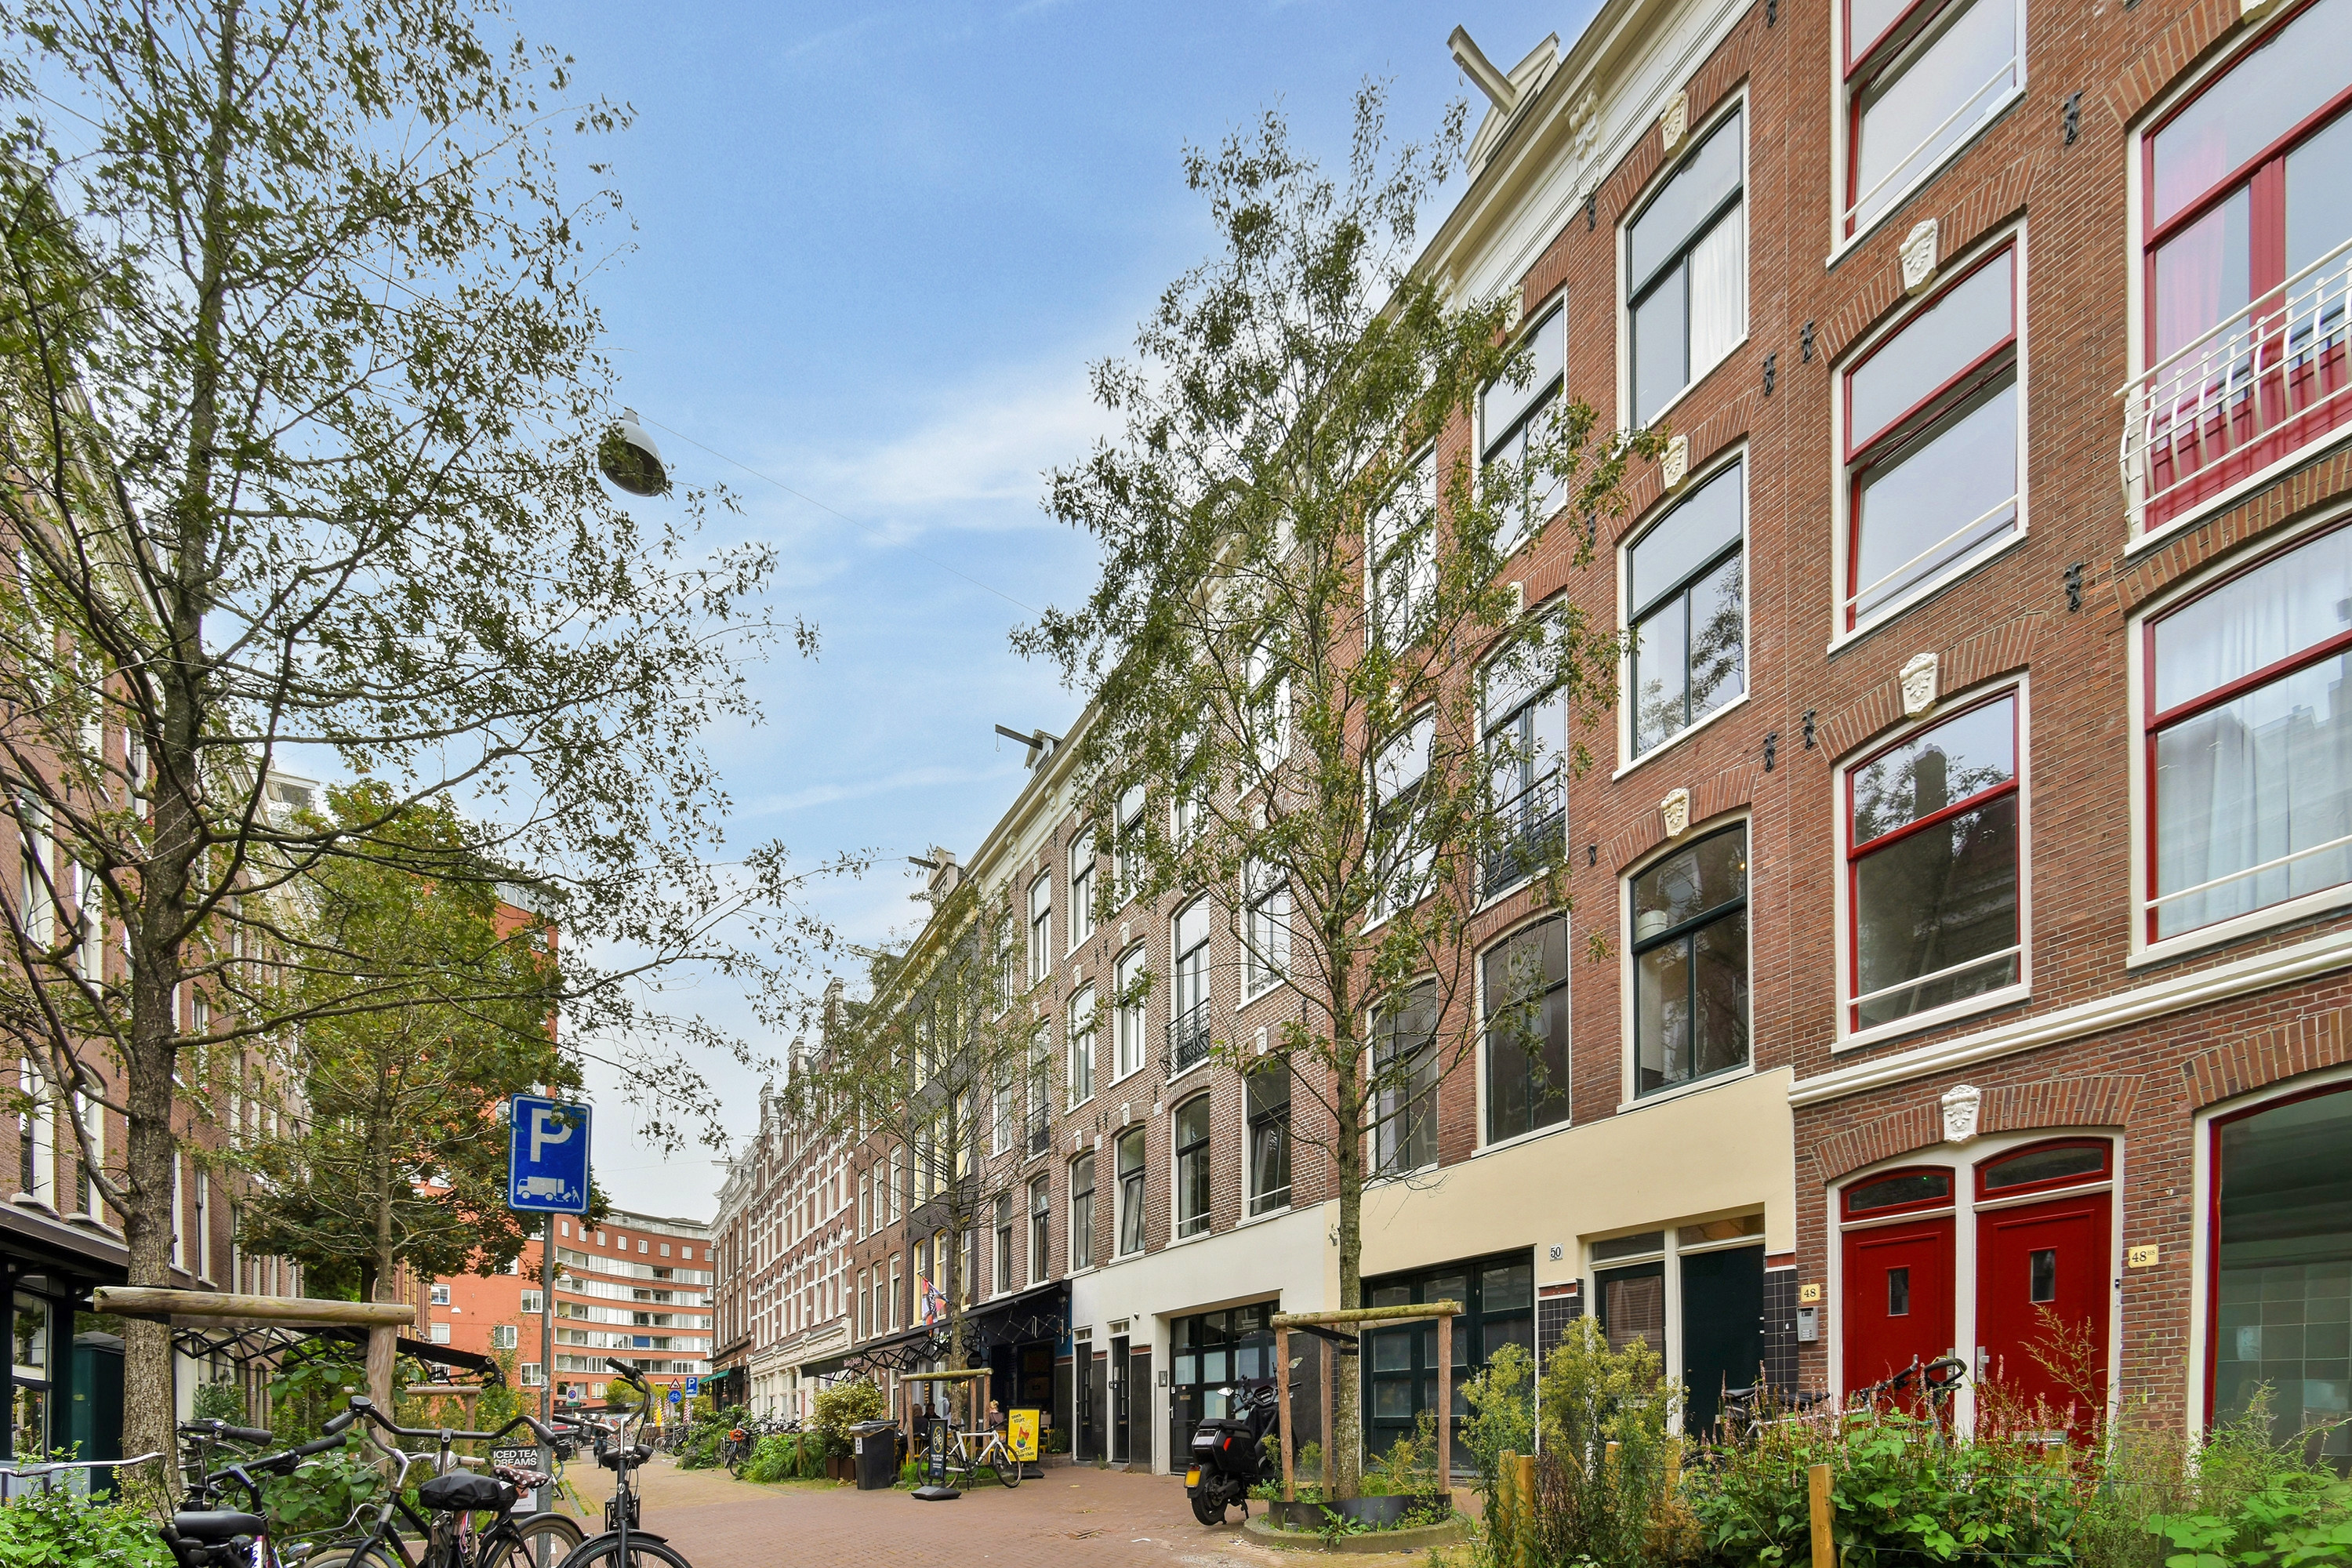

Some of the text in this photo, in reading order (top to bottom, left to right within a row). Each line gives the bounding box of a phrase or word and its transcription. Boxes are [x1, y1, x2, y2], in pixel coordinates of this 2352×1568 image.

[530, 1108, 572, 1163] P
[1551, 1247, 1561, 1258] 50
[1804, 1288, 1817, 1298] 48
[688, 1378, 695, 1388] P
[493, 1450, 517, 1459] ICED
[494, 1457, 537, 1467] DREAMS
